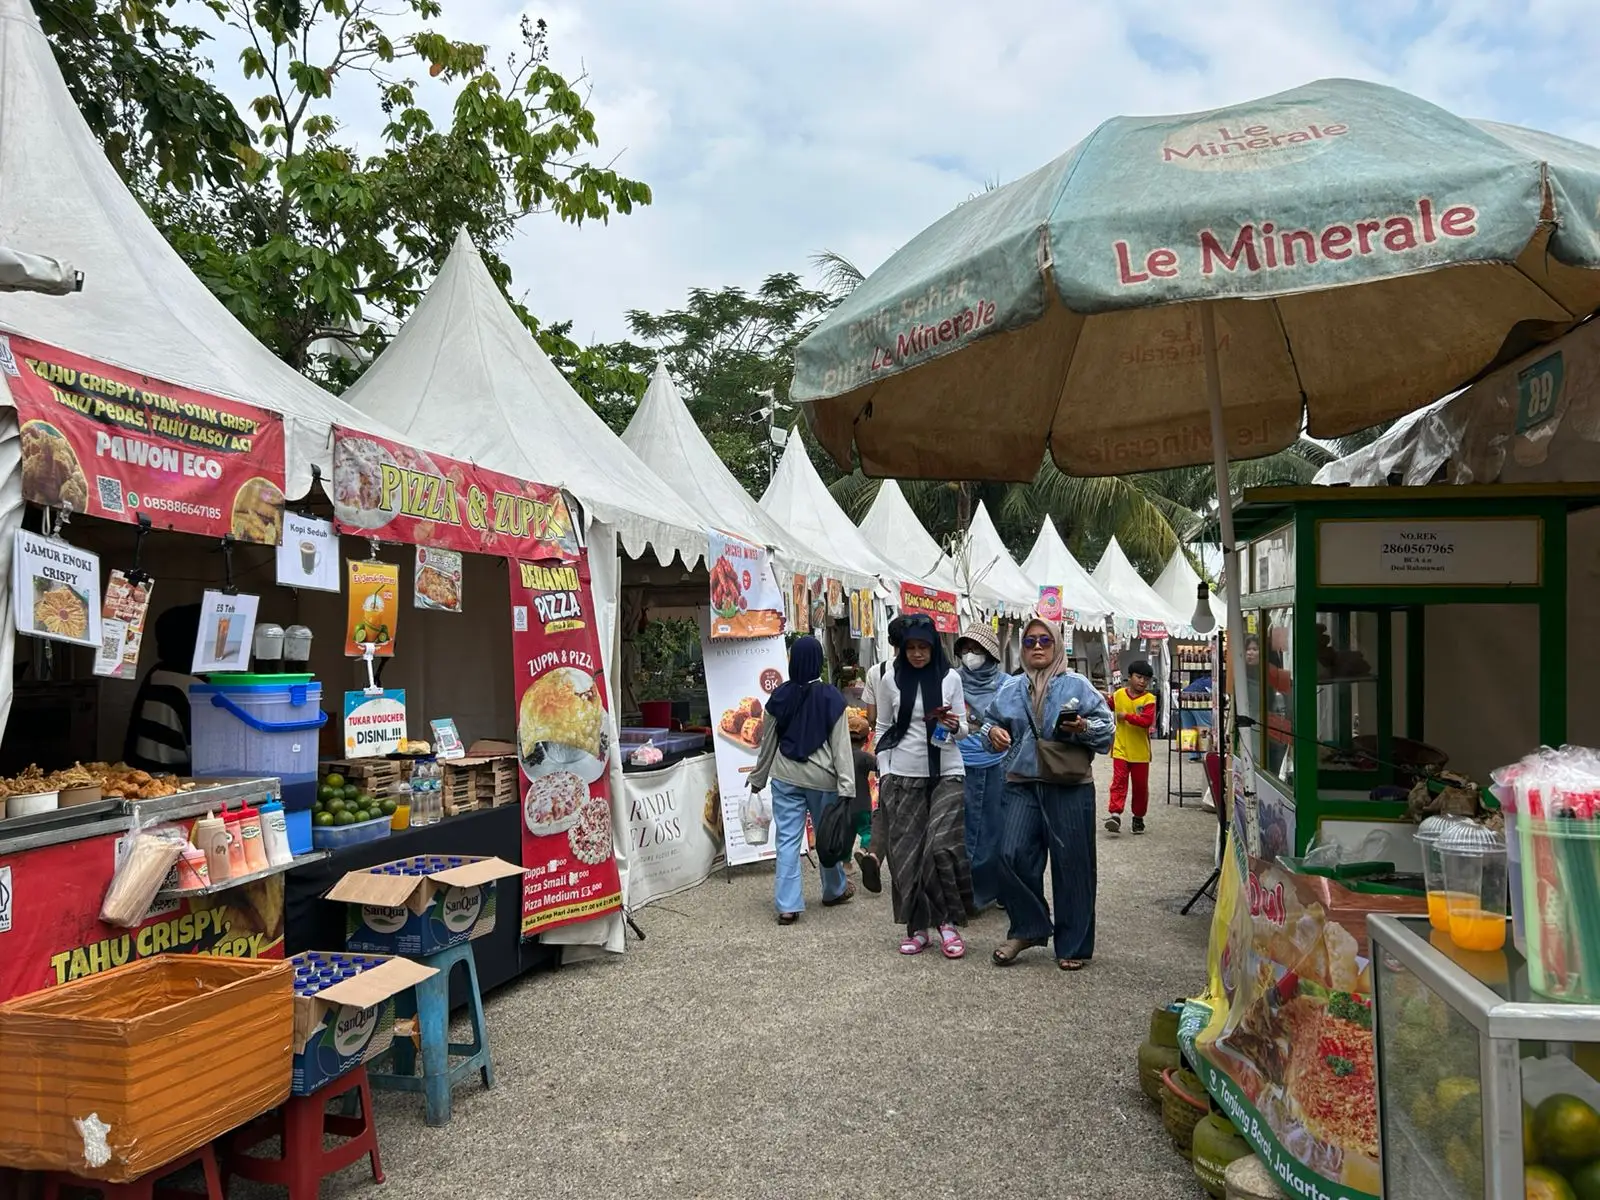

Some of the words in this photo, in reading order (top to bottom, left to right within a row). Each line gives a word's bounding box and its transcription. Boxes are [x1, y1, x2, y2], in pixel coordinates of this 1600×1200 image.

[1163, 123, 1350, 162] Minerale
[1218, 124, 1269, 141] Le
[1114, 240, 1181, 285] Le
[1199, 197, 1479, 274] Minerale
[871, 345, 894, 370] Le
[896, 300, 997, 359] Minerale
[25, 358, 77, 386] TAHU
[80, 372, 140, 404] CRISPY,
[142, 390, 219, 424] OTAK-OTAK
[220, 412, 261, 435] CRISPY
[1528, 370, 1554, 418] 89
[48, 385, 93, 415] TAHU
[151, 415, 189, 437] TAHU
[96, 431, 179, 474] PAWON
[183, 452, 223, 479] ECO
[143, 496, 222, 519] 085886647185
[380, 463, 462, 526] PIZZA
[466, 484, 488, 530] &
[493, 490, 567, 540] ZUPPA
[290, 524, 306, 534] Kopi
[307, 527, 328, 538] Seduh
[1400, 532, 1437, 541] NO.REK
[24, 541, 61, 562] JAMUR
[62, 553, 92, 571] ENOKI
[1383, 543, 1455, 554] 2860567965
[43, 566, 78, 584] CRISPY
[520, 562, 582, 593] BERAND
[534, 591, 581, 623] PIZZA
[527, 651, 560, 677] ZUPPA
[561, 650, 568, 663] &
[765, 679, 778, 690] 8K
[349, 717, 371, 726] TUKAR
[372, 713, 405, 723] VOUCHER
[630, 789, 677, 822] RINDU
[524, 883, 542, 897] Pizza
[543, 875, 567, 890] Small
[524, 899, 542, 912] Pizza
[543, 890, 579, 905] Medium
[363, 905, 406, 918] SanQua
[445, 895, 479, 915] SanQua
[51, 934, 130, 985] TAHU
[136, 905, 231, 957] CRISPY,
[337, 1006, 375, 1038] SanQua
[1221, 1079, 1250, 1133] Tanjung
[1251, 1118, 1273, 1166] Barat,
